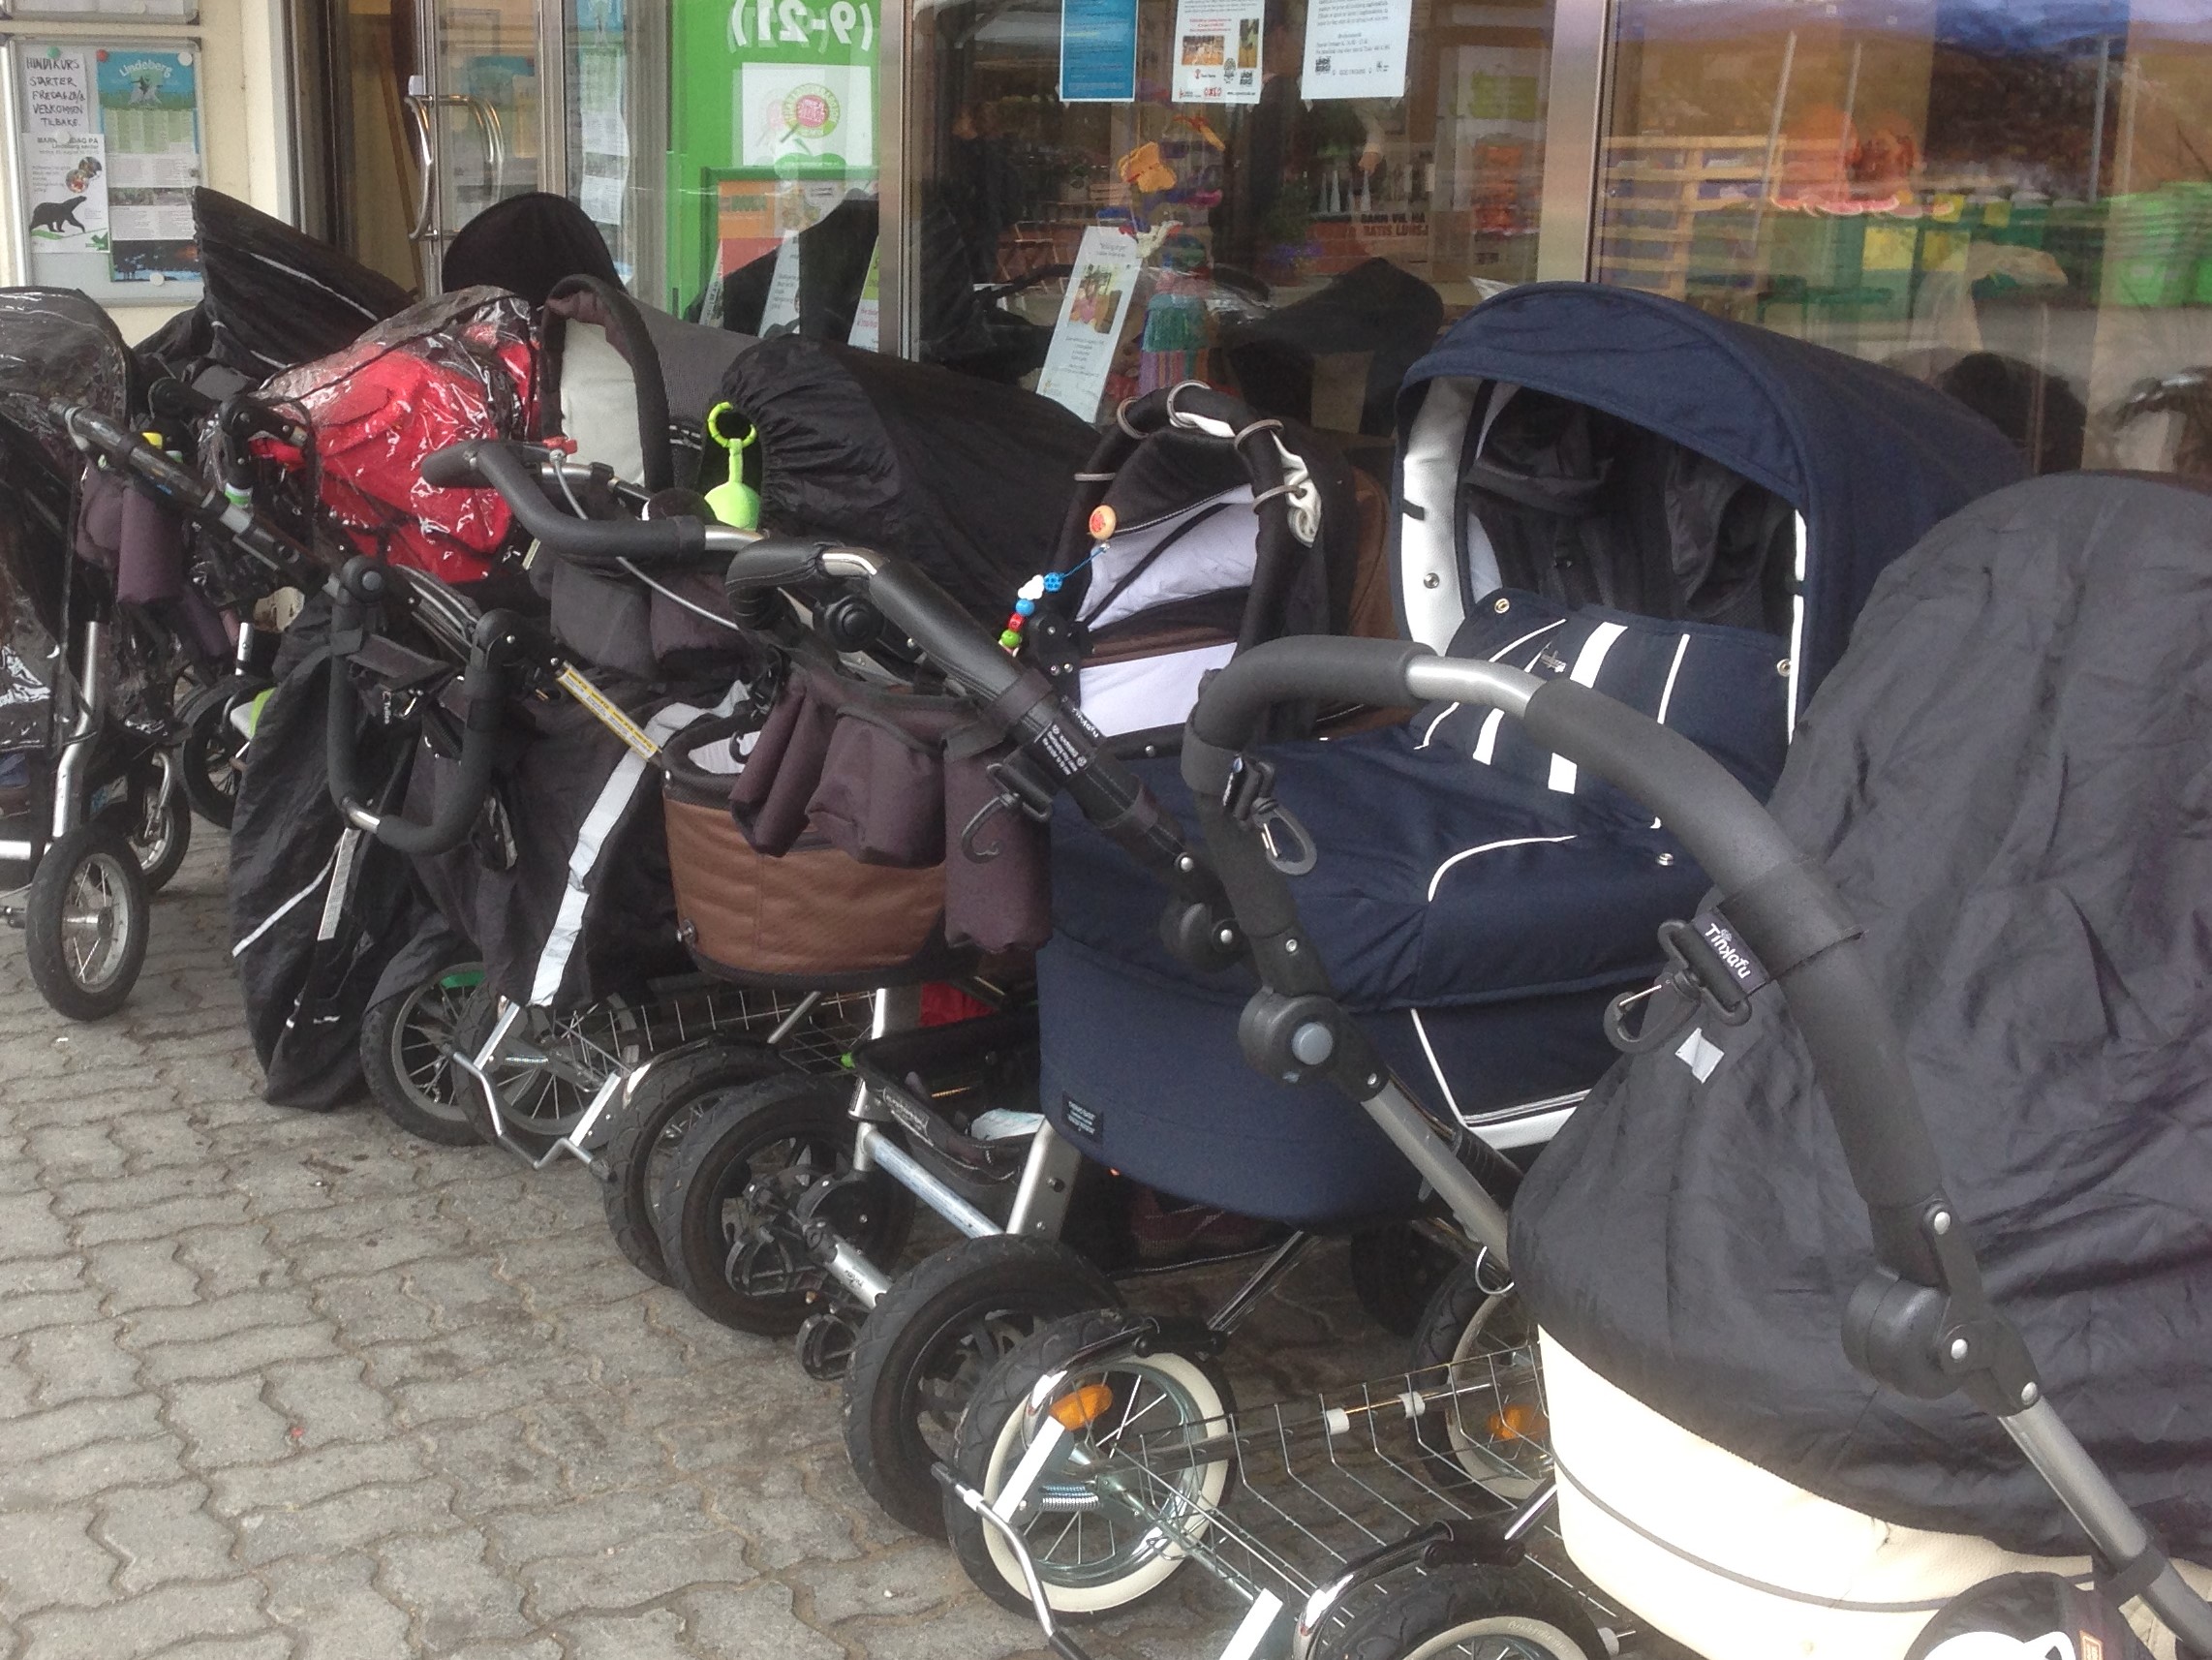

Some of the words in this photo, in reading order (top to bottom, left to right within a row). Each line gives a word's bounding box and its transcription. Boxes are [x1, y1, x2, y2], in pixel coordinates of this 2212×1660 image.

[118, 59, 172, 78] Lindeberg
[29, 77, 77, 87] STARTER
[1705, 923, 1751, 979] Tinkafu
